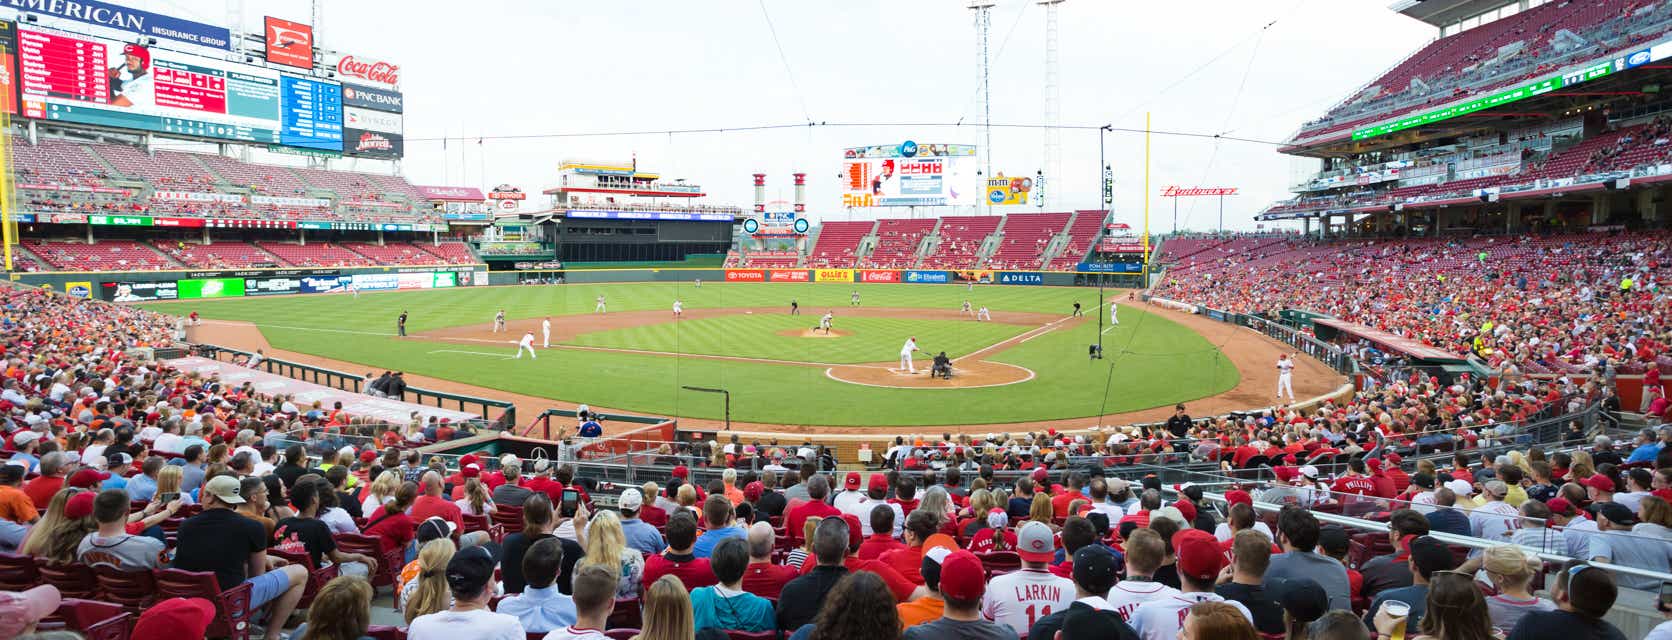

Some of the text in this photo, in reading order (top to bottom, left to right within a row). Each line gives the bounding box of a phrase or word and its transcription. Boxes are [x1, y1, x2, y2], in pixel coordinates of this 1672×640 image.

[152, 26, 199, 41] INSURANCE
[200, 36, 226, 46] GROUP
[338, 55, 399, 84] Coca-Cola
[737, 271, 762, 279] TOYOTA
[1011, 273, 1041, 283] DELTA
[1345, 480, 1373, 492] PHILLIPS
[1015, 584, 1061, 603] LARKIN
